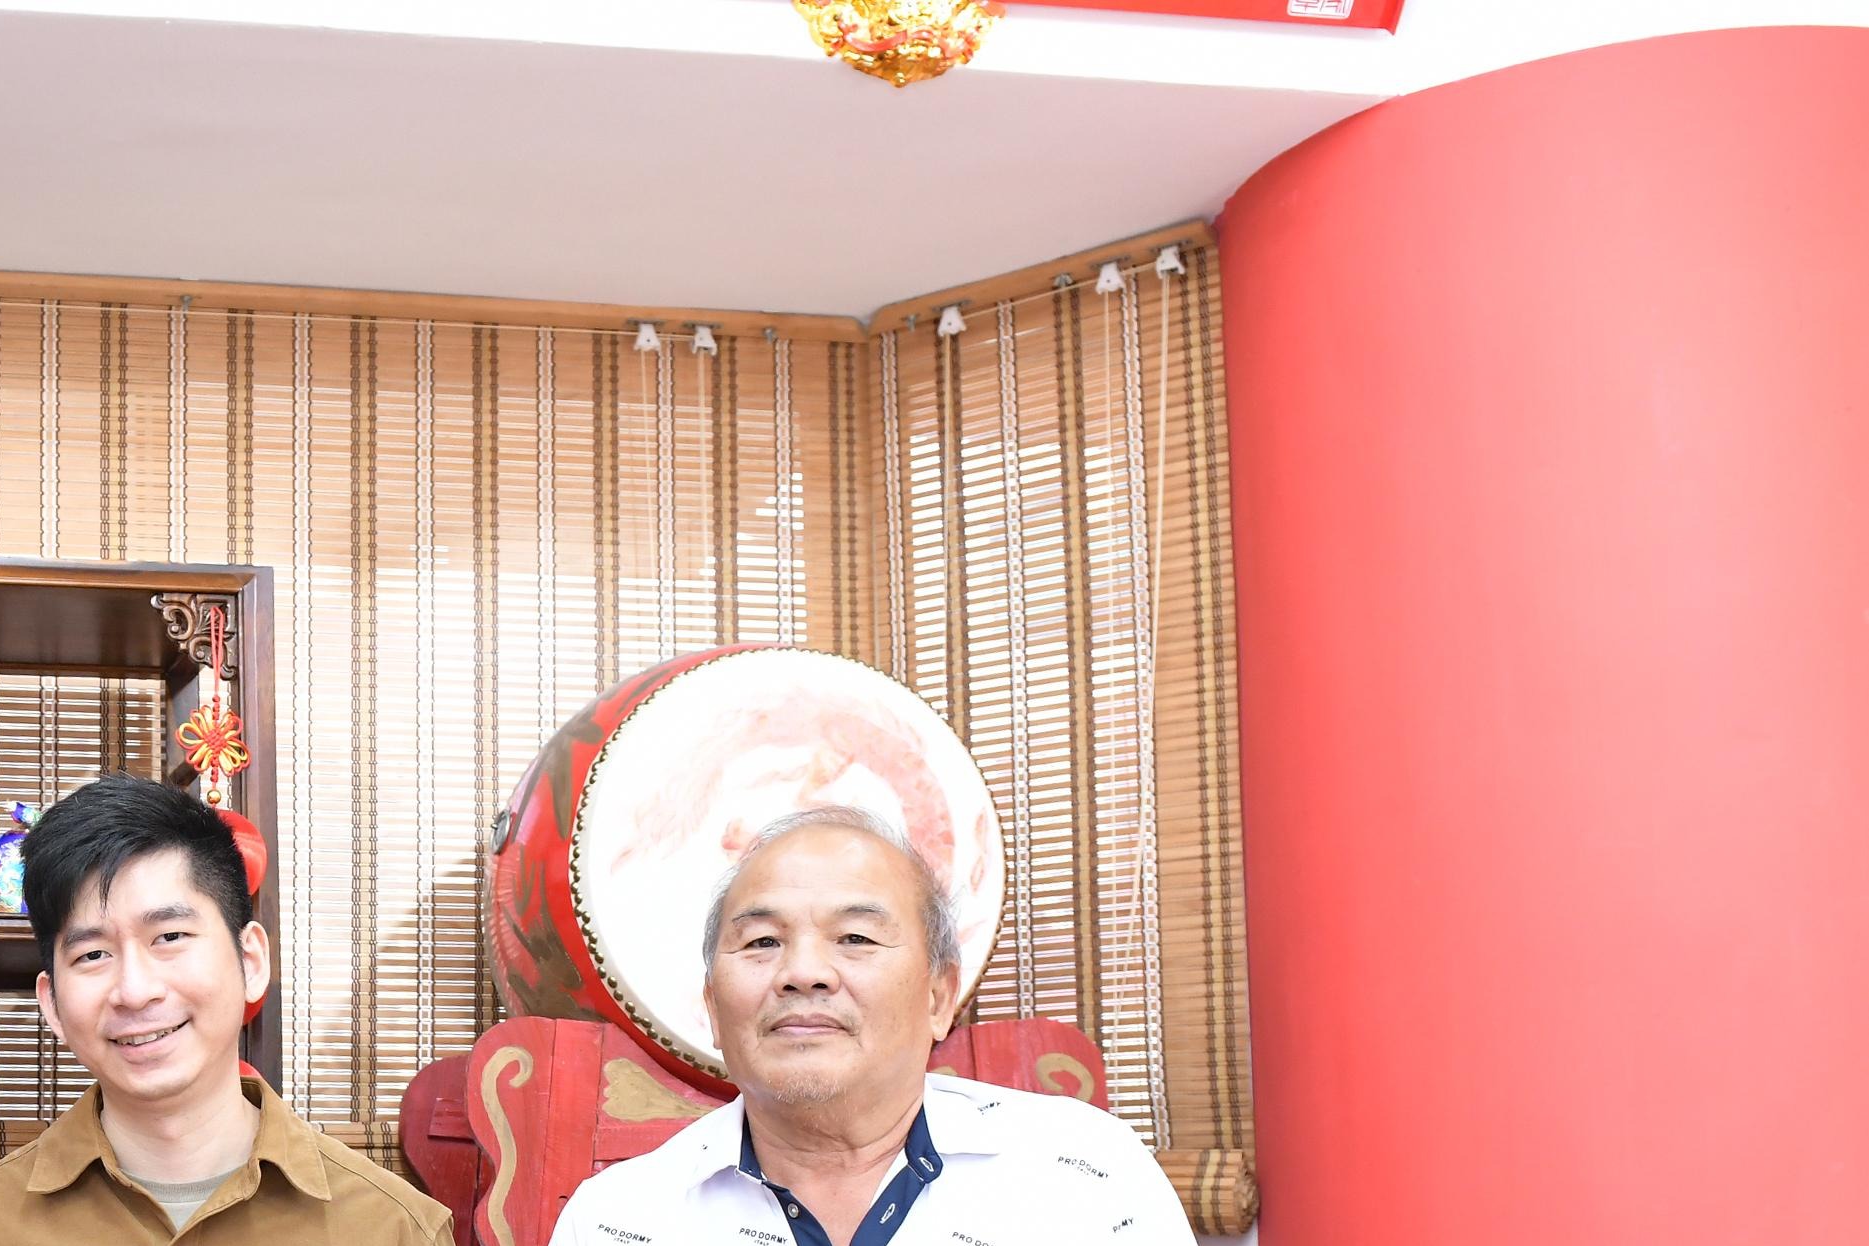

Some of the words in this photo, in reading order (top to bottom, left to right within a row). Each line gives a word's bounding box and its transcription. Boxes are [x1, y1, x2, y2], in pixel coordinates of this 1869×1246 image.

[597, 1223, 618, 1237] PRO
[618, 1230, 653, 1244] DORMY
[739, 1227, 758, 1238] PRO
[758, 1231, 788, 1245] DORMY
[952, 1231, 973, 1244] PRO
